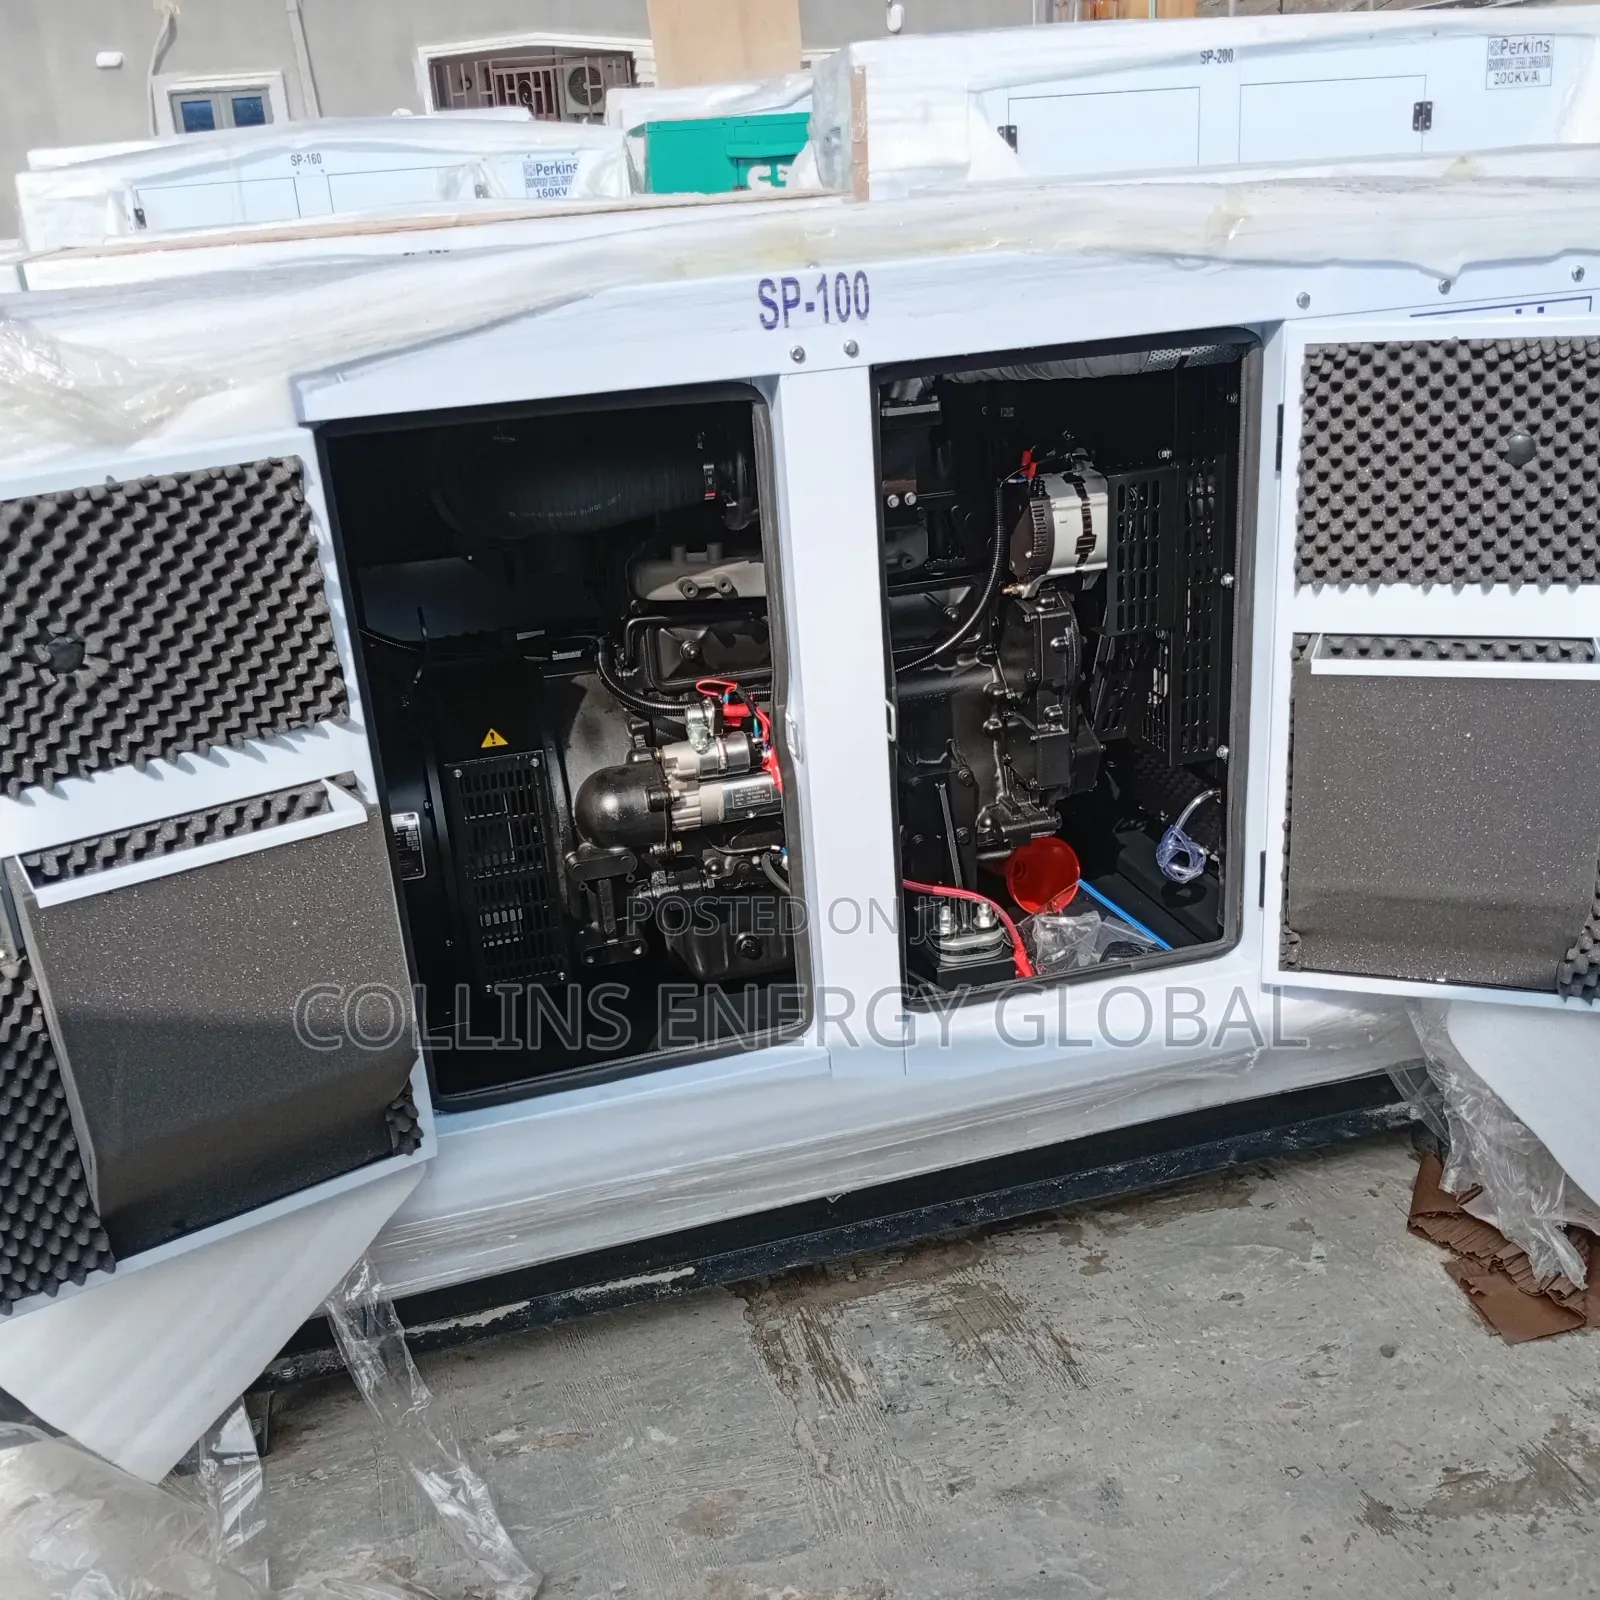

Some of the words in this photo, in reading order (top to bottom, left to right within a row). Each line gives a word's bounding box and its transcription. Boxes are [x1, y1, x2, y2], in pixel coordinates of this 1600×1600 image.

[1500, 36, 1550, 55] Perkins
[1200, 48, 1233, 64] SP-200
[290, 153, 322, 167] SP-160
[536, 160, 578, 176] Perkins
[758, 269, 869, 330] SP-100
